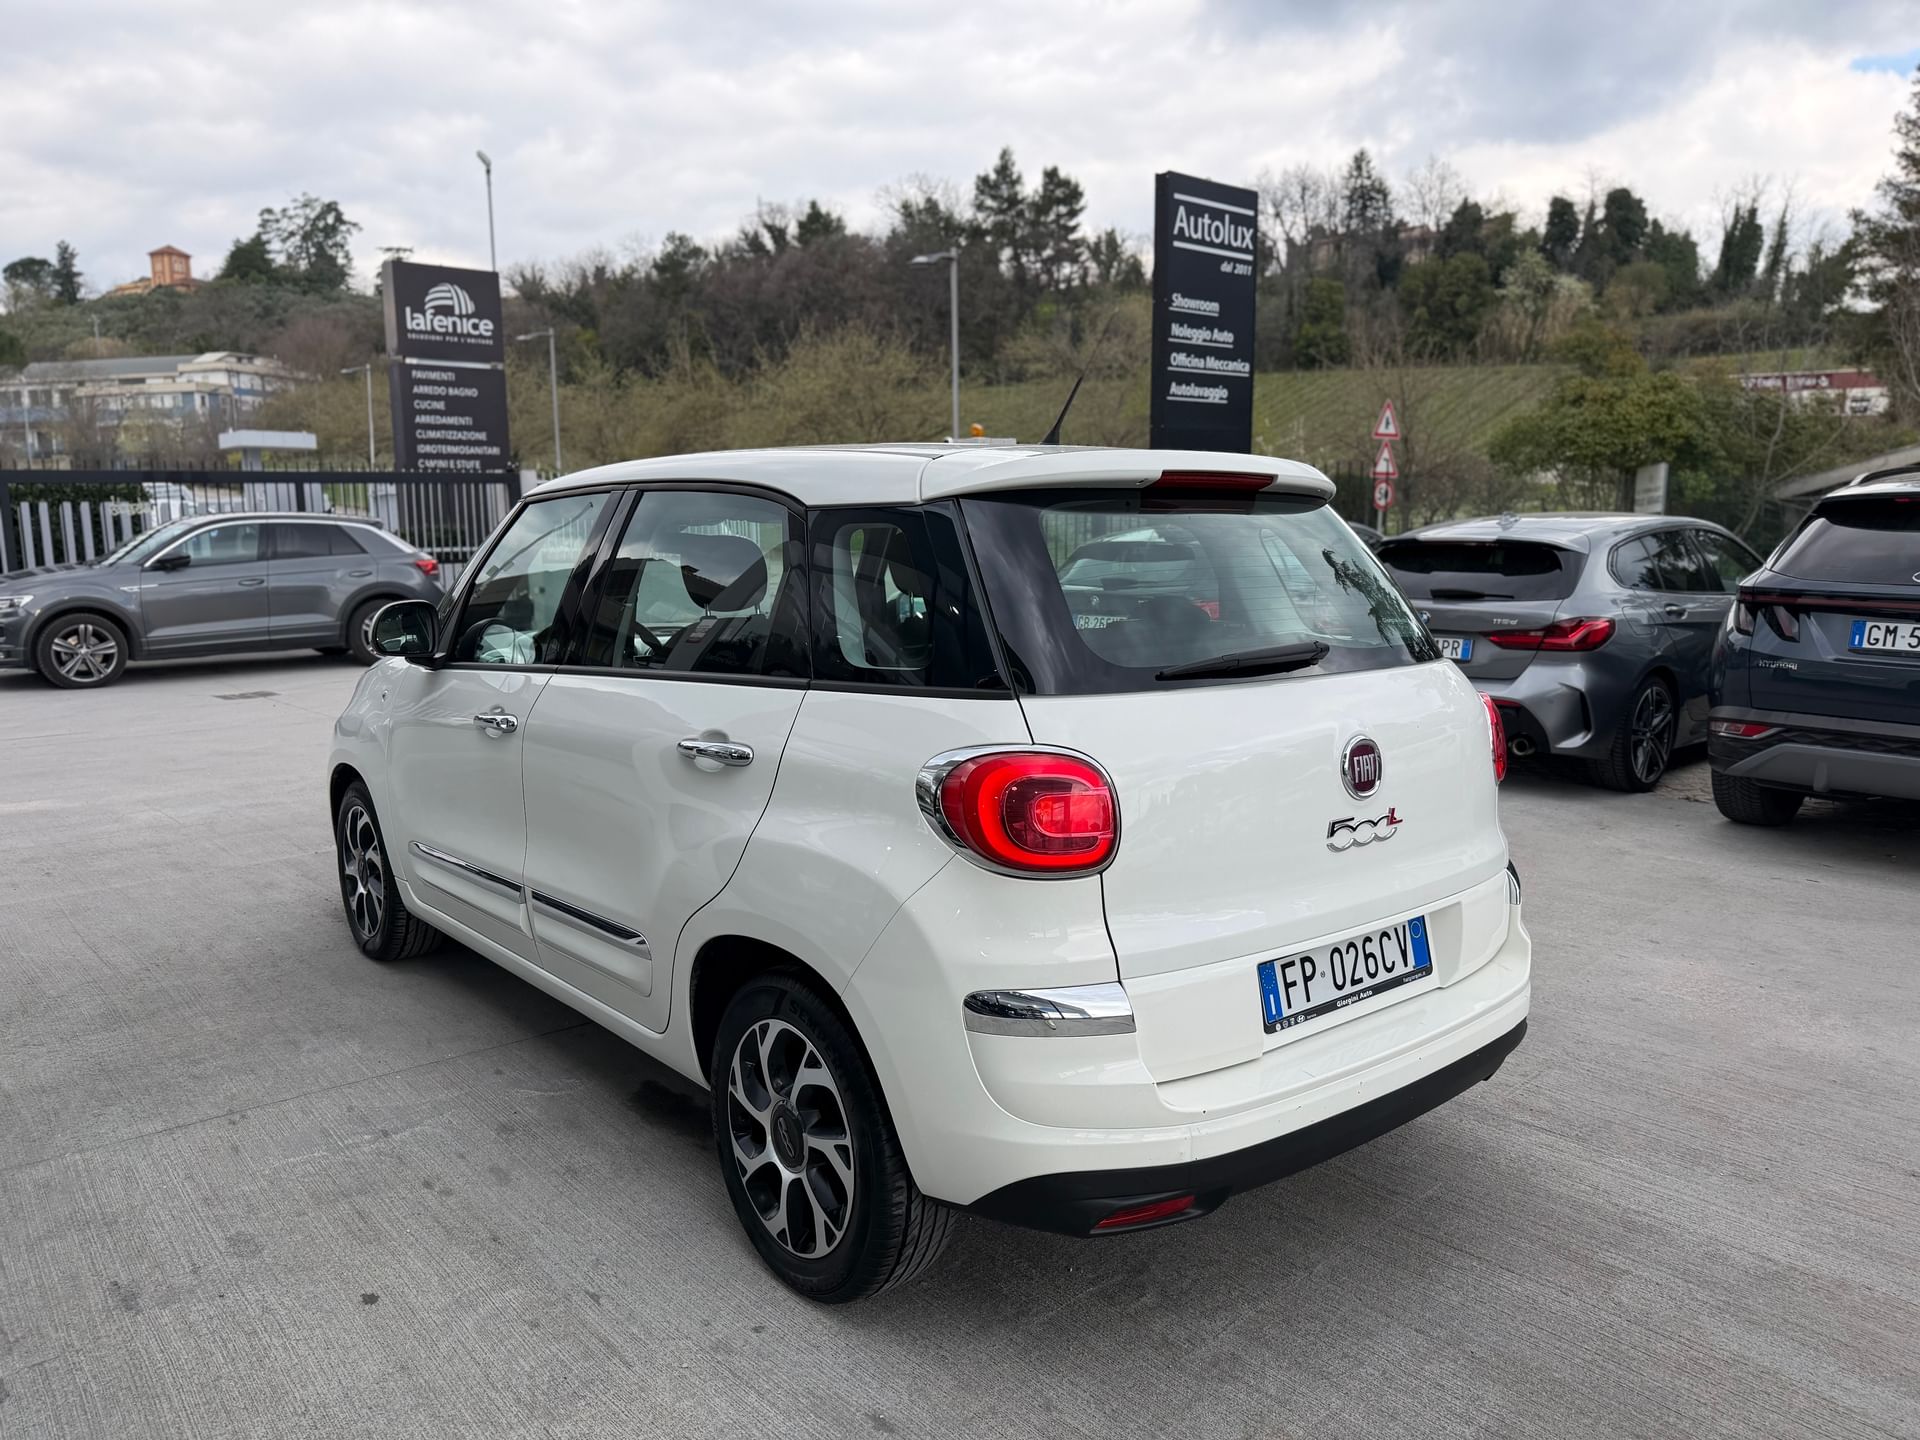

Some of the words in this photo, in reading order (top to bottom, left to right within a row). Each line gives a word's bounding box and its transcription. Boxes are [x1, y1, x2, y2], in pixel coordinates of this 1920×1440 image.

[1173, 205, 1254, 250] Autolux
[1220, 260, 1233, 274] dal
[1171, 293, 1220, 312] Showroom
[405, 306, 494, 337] lafenice
[1171, 323, 1212, 344] Noleggio
[1212, 328, 1234, 343] Auto
[1170, 352, 1205, 369] Officina
[1205, 356, 1250, 373] Meccanica
[411, 369, 456, 382] PAVIMENTI
[412, 385, 447, 397] ARREDO
[448, 387, 478, 398] BAGNO
[1169, 382, 1229, 401] Autolavaggio
[413, 400, 446, 411] CUCINE
[415, 415, 473, 427] ARREDAMENTI
[416, 429, 487, 441] CLIMATIZZAZIONE
[416, 444, 500, 456] IDROTERMOSANITARI
[1867, 624, 1898, 648] GM
[1435, 638, 1460, 657] PR
[1354, 753, 1375, 784] FIAT
[1280, 956, 1317, 1010] FP
[1330, 924, 1409, 991] 026CV
[1360, 990, 1373, 999] Auto
